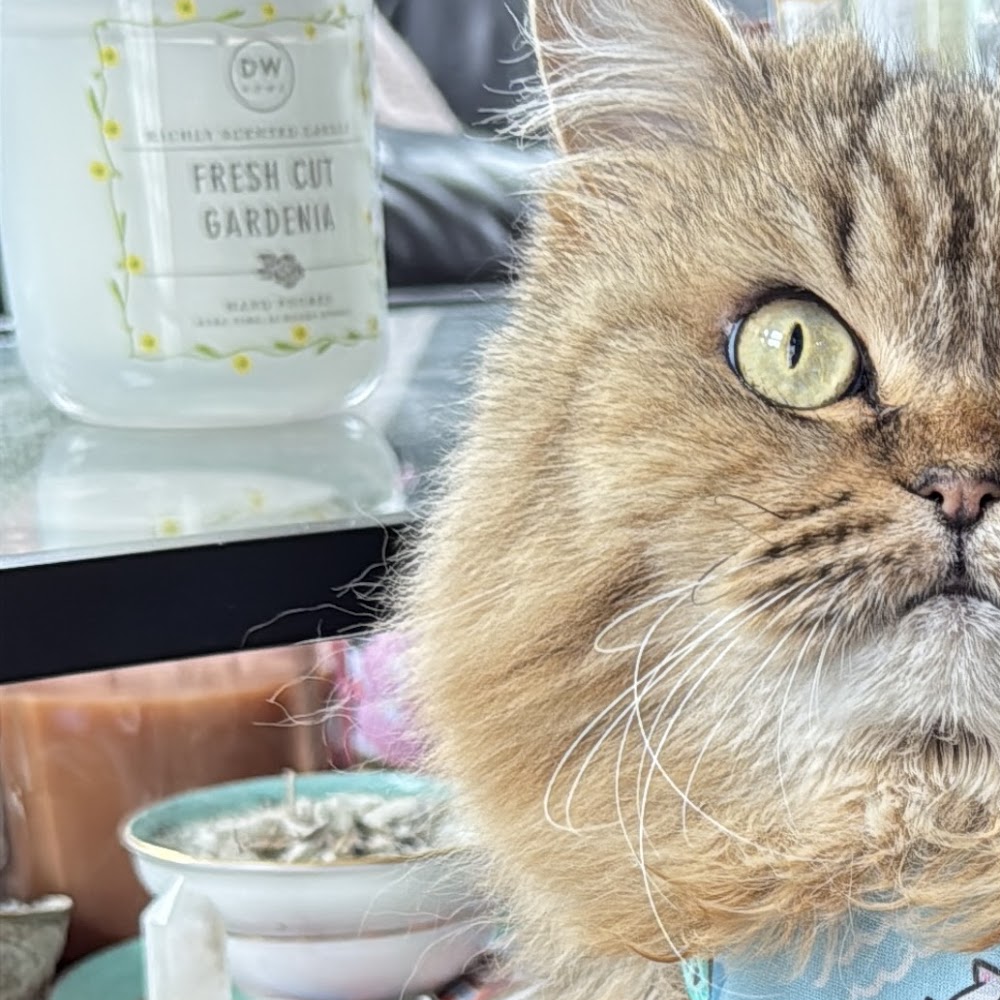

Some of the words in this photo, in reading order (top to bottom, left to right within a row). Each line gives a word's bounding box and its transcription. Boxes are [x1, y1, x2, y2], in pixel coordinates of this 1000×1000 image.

[240, 57, 282, 78] DW
[193, 160, 280, 193] FRESH
[293, 158, 333, 190] CUT
[204, 203, 335, 239] GARDENIA
